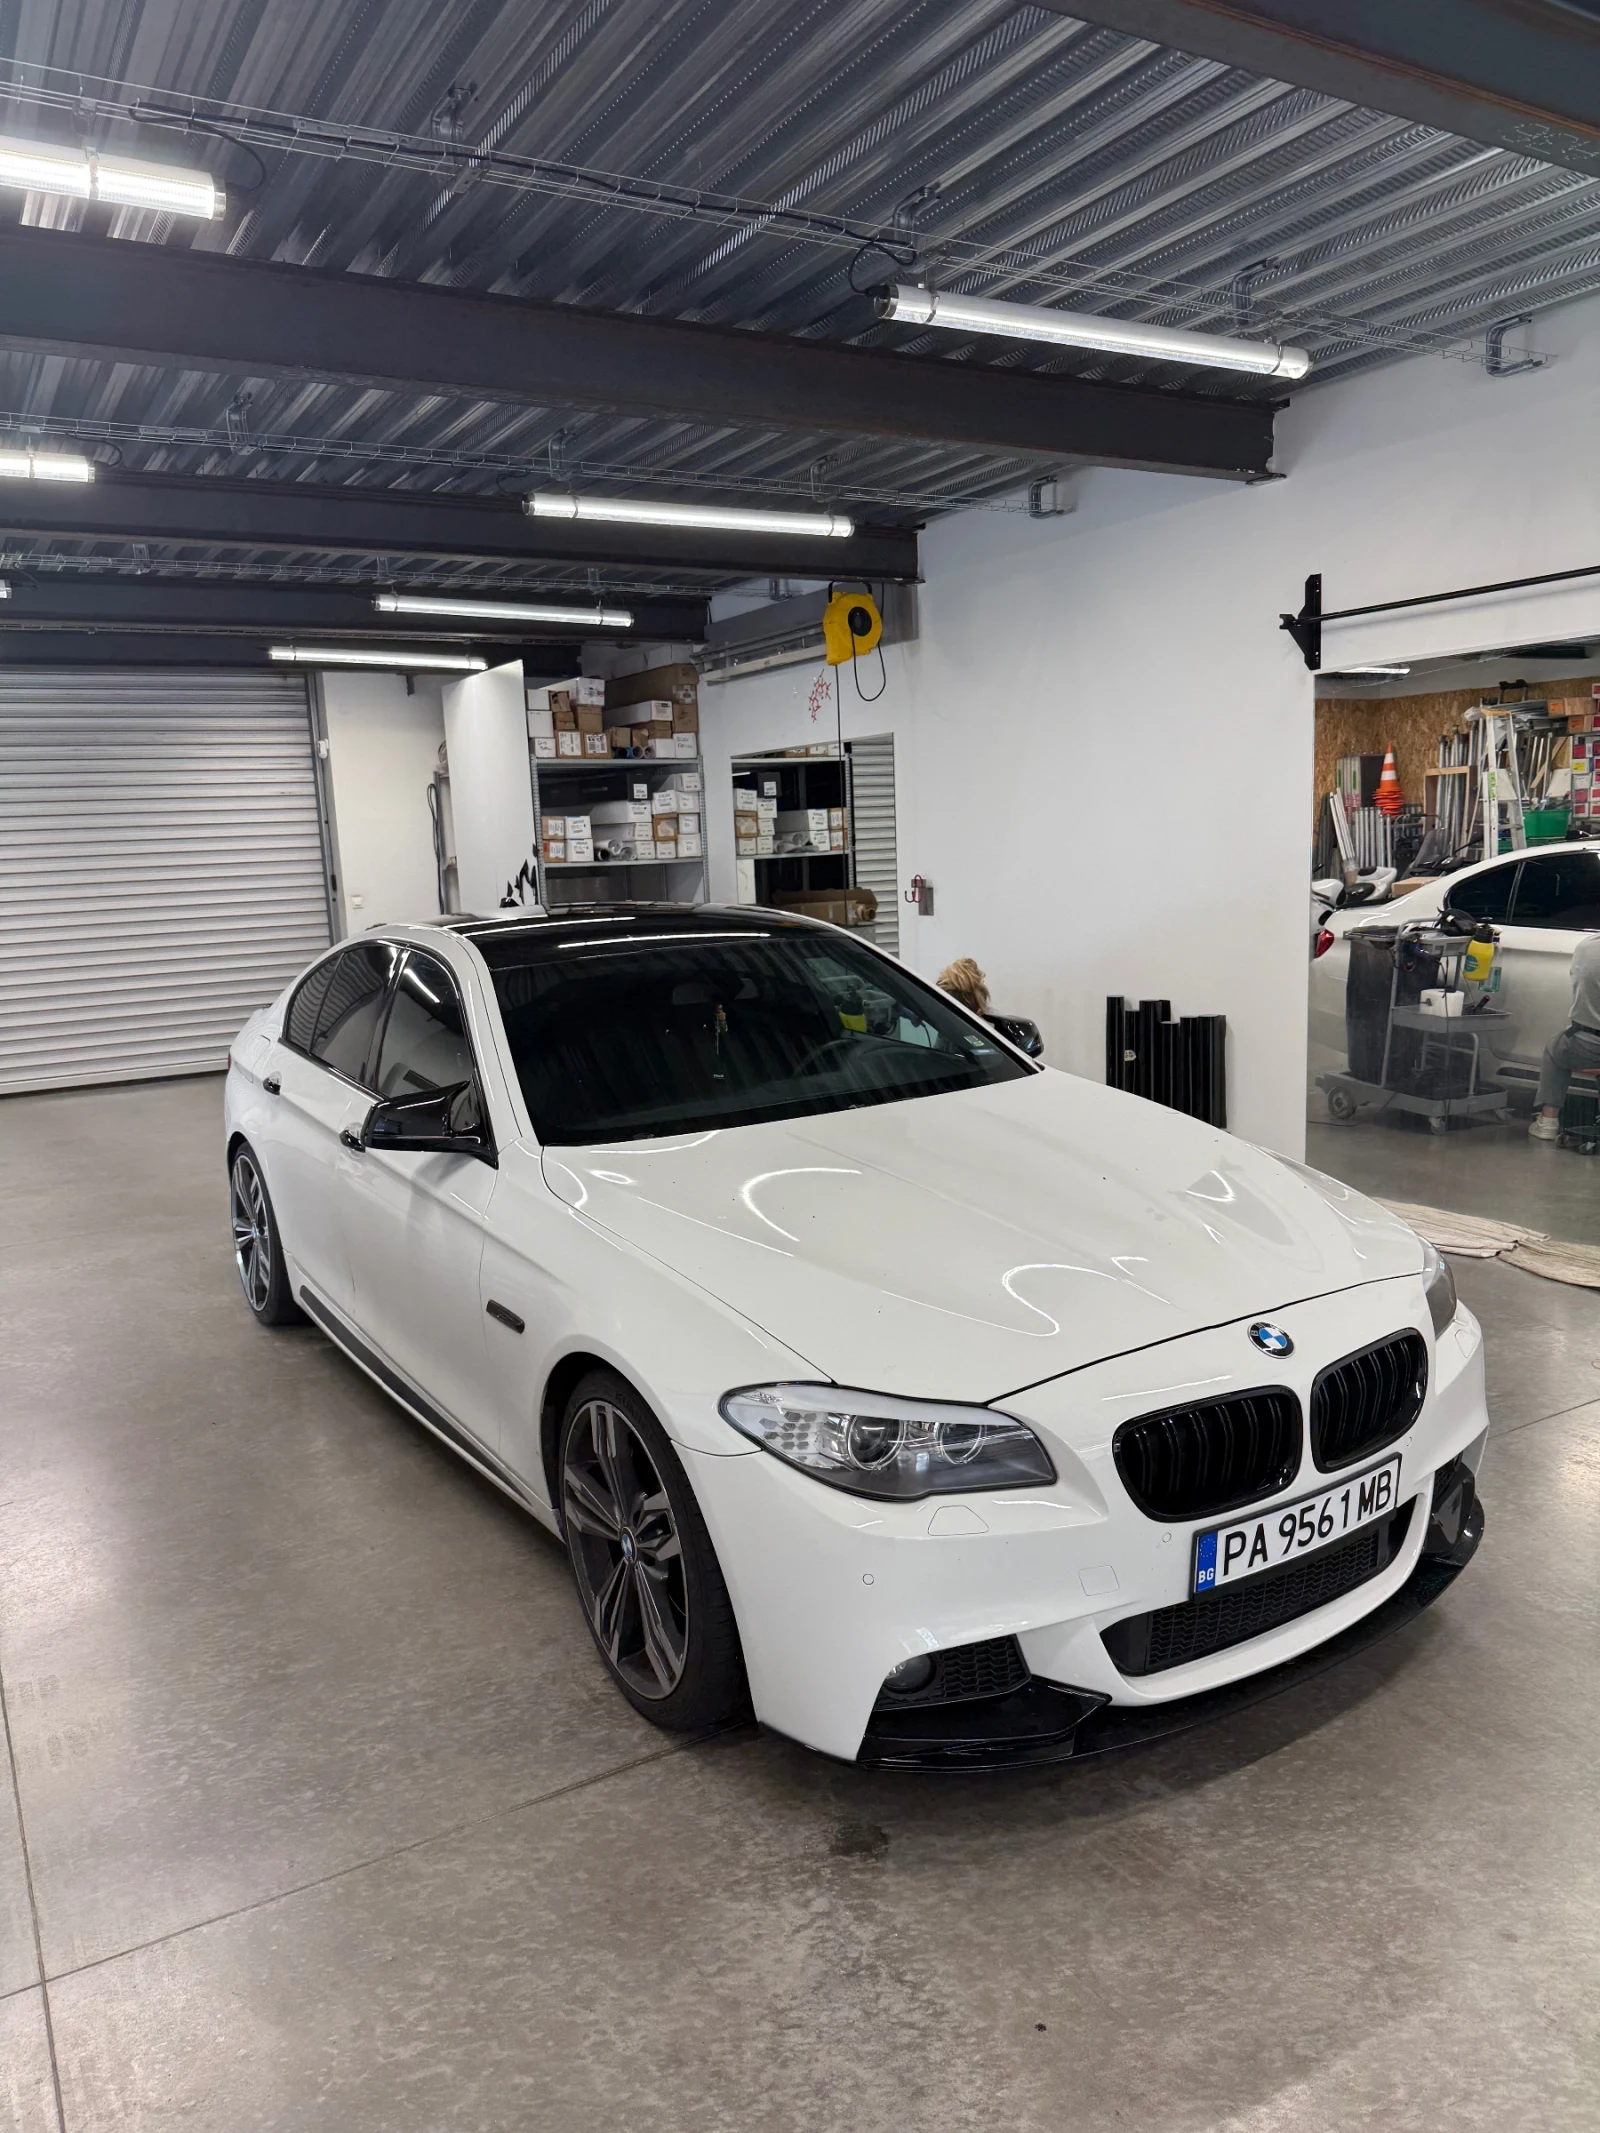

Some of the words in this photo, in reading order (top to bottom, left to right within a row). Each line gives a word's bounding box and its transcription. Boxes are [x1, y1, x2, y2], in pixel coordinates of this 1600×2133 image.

[1223, 1523, 1268, 1576] PA
[1279, 1488, 1351, 1556] 9561
[1356, 1469, 1392, 1522] MB
[1198, 1567, 1215, 1584] BG
